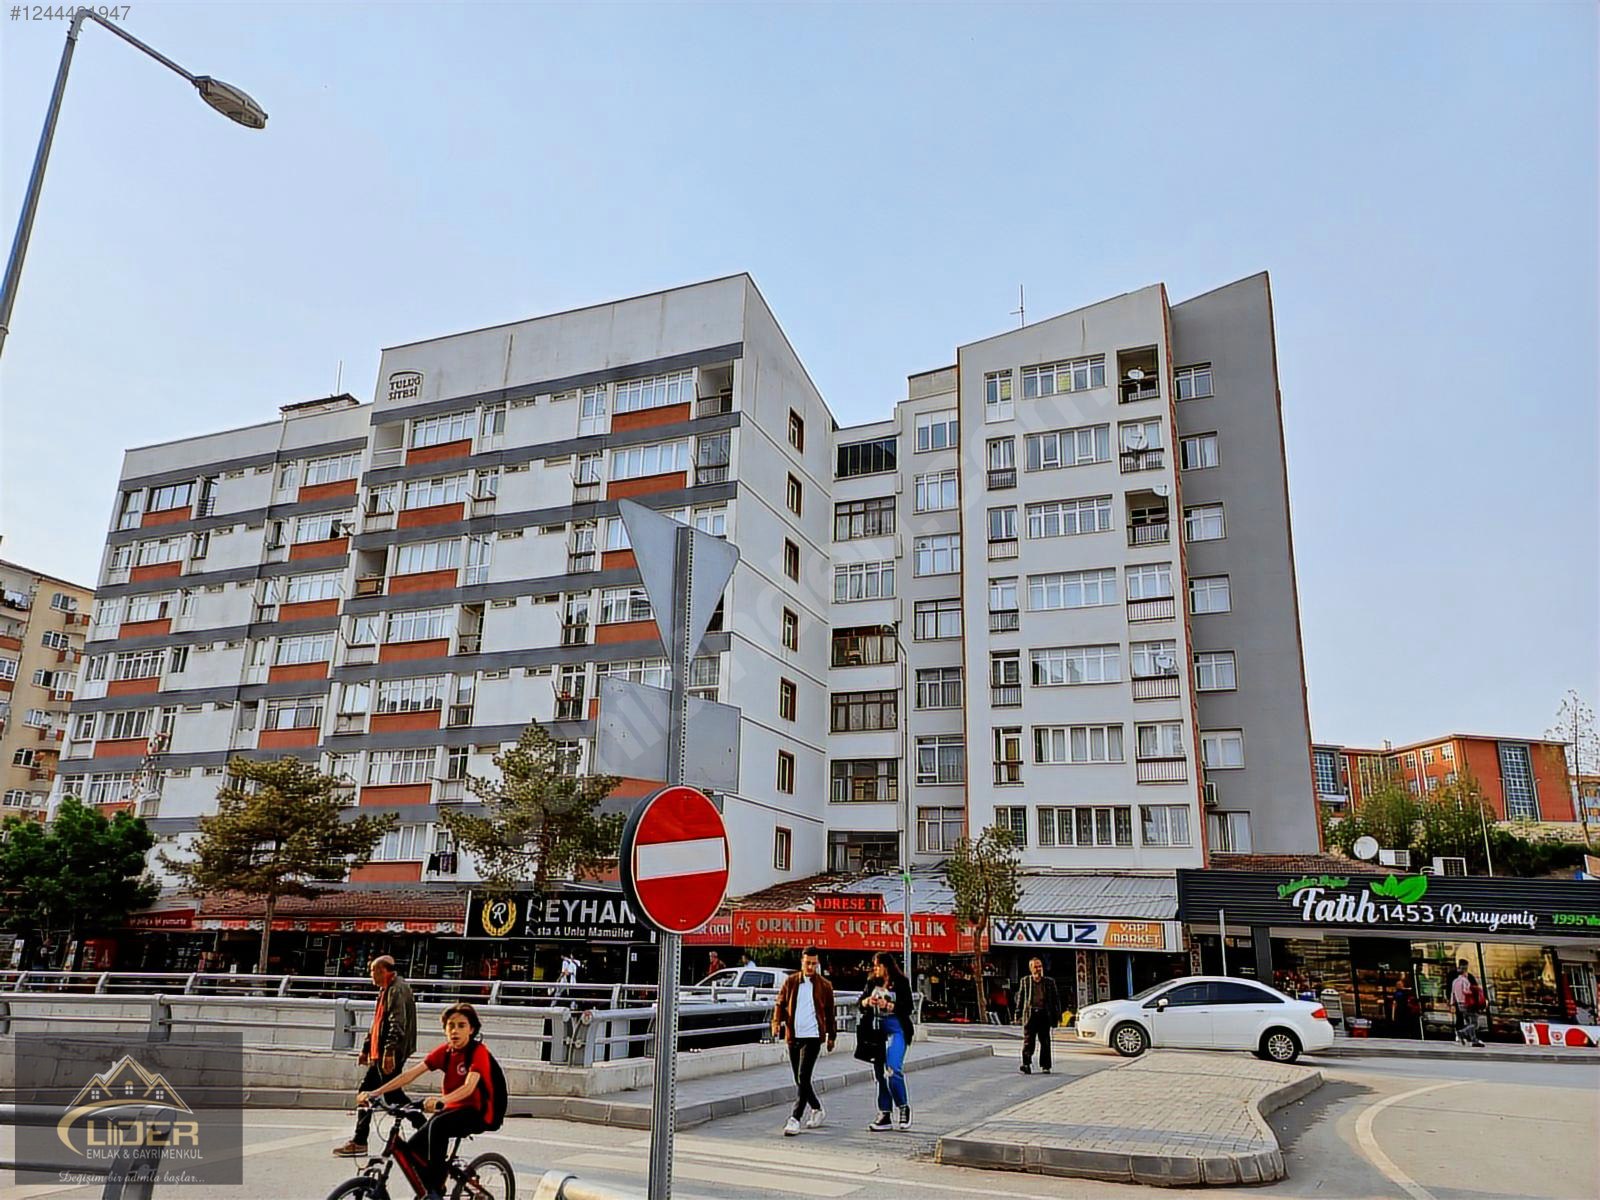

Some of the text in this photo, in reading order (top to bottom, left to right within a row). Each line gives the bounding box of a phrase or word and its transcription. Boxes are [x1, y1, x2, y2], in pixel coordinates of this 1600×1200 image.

[1292, 888, 1380, 923] Fatih
[1380, 904, 1434, 923] 1453
[1440, 903, 1538, 931] Kuruyemiş
[756, 914, 825, 932] ORKİDE
[1120, 923, 1148, 932] YAPI
[525, 925, 550, 936] Psta
[588, 926, 634, 938] Mamüller
[994, 922, 1097, 944] YAVUZ
[1110, 934, 1160, 944] MARKET
